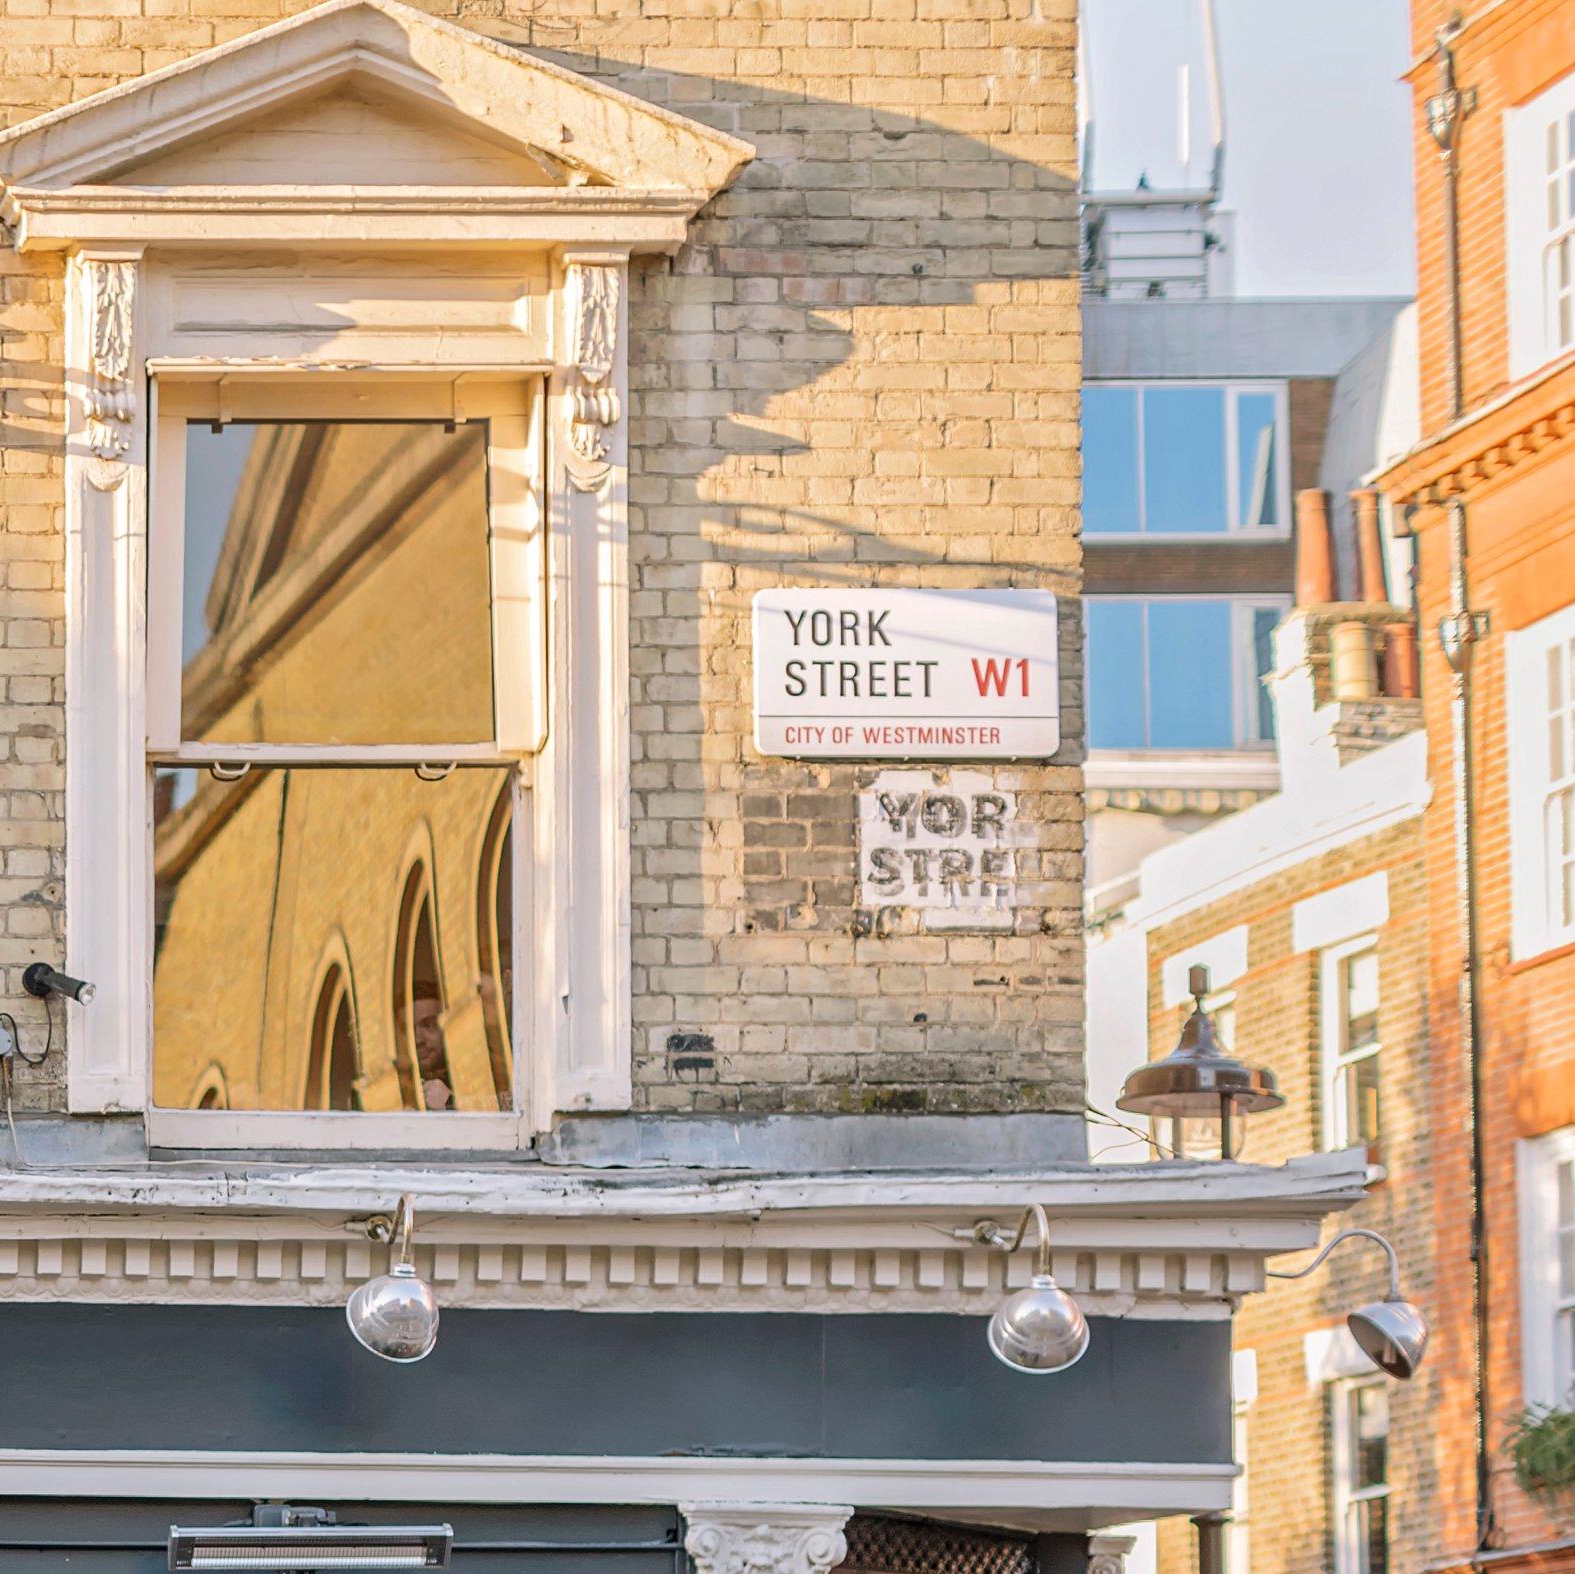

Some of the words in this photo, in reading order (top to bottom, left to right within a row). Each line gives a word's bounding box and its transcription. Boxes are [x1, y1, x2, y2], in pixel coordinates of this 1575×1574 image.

[784, 609, 892, 646] YORK
[784, 660, 939, 698] STREET
[971, 657, 1030, 697] W1
[785, 726, 825, 745] CITY
[832, 726, 854, 745] OF
[863, 726, 1001, 745] WESTMINSTER
